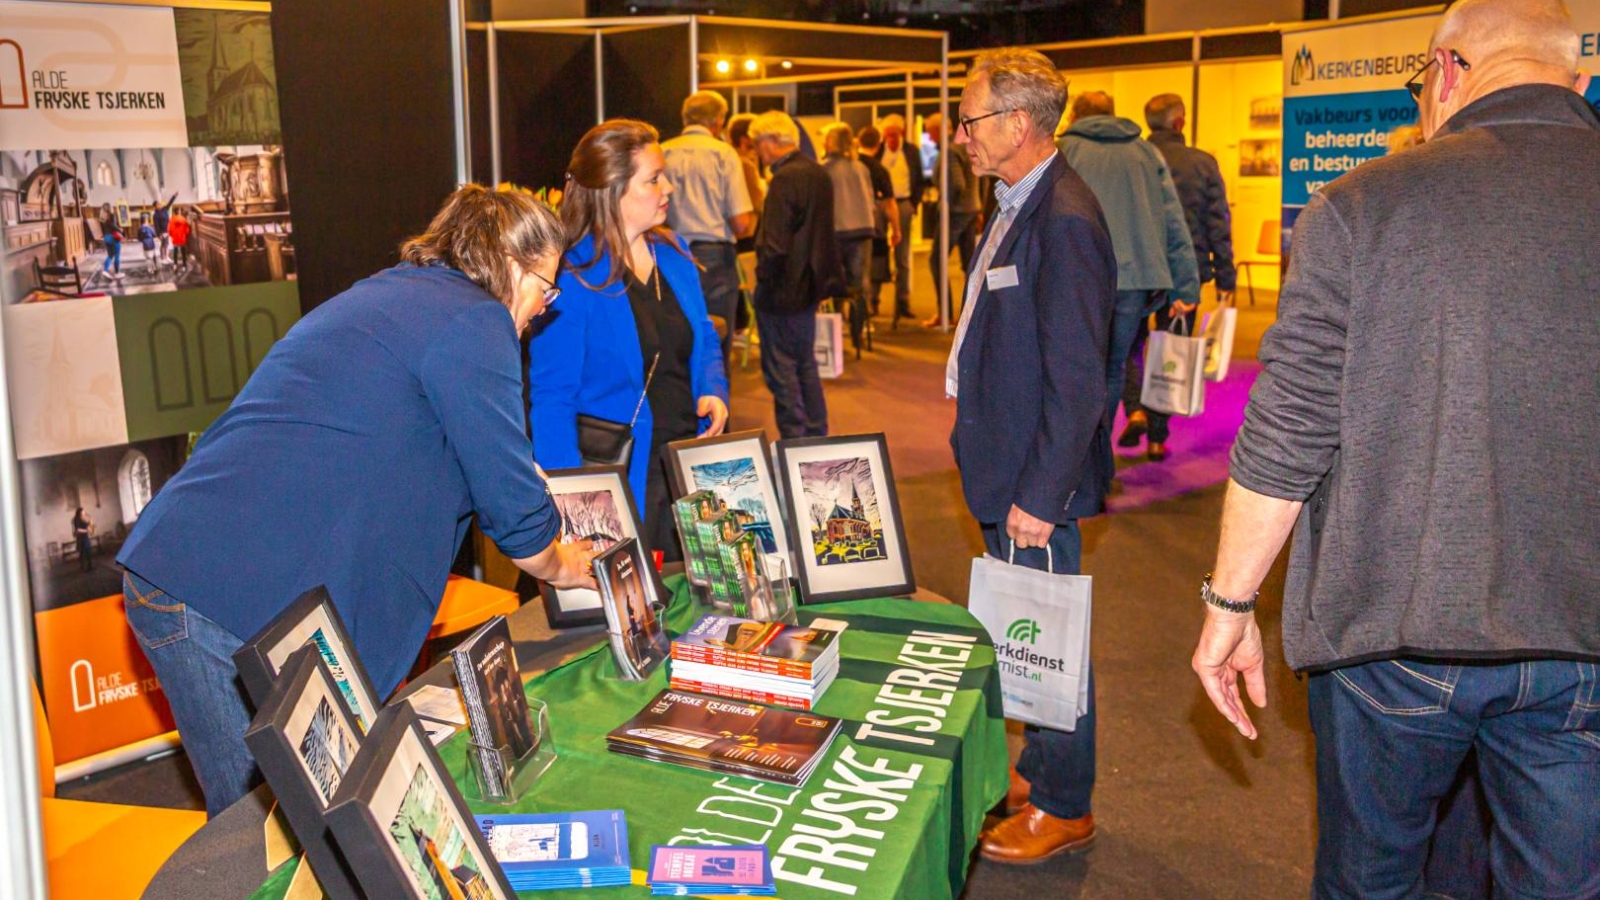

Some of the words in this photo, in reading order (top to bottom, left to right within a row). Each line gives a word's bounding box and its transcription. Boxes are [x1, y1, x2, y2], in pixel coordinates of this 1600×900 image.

[1317, 53, 1426, 80] KERKENBEURS
[32, 70, 69, 90] ALDE
[34, 91, 91, 109] FRYSKE
[97, 91, 166, 109] TSJERKEN
[1295, 106, 1372, 126] Vakbeurs
[1378, 106, 1419, 122] voor
[1289, 157, 1309, 171] en
[1313, 153, 1372, 172] bestu
[97, 671, 122, 691] ALDE
[99, 681, 139, 705] FRYSKE
[663, 691, 705, 708] FRYSKE
[706, 700, 759, 718] TSJERKEN
[770, 745, 924, 896] FRYSKE
[855, 629, 978, 746] TSJERKEN
